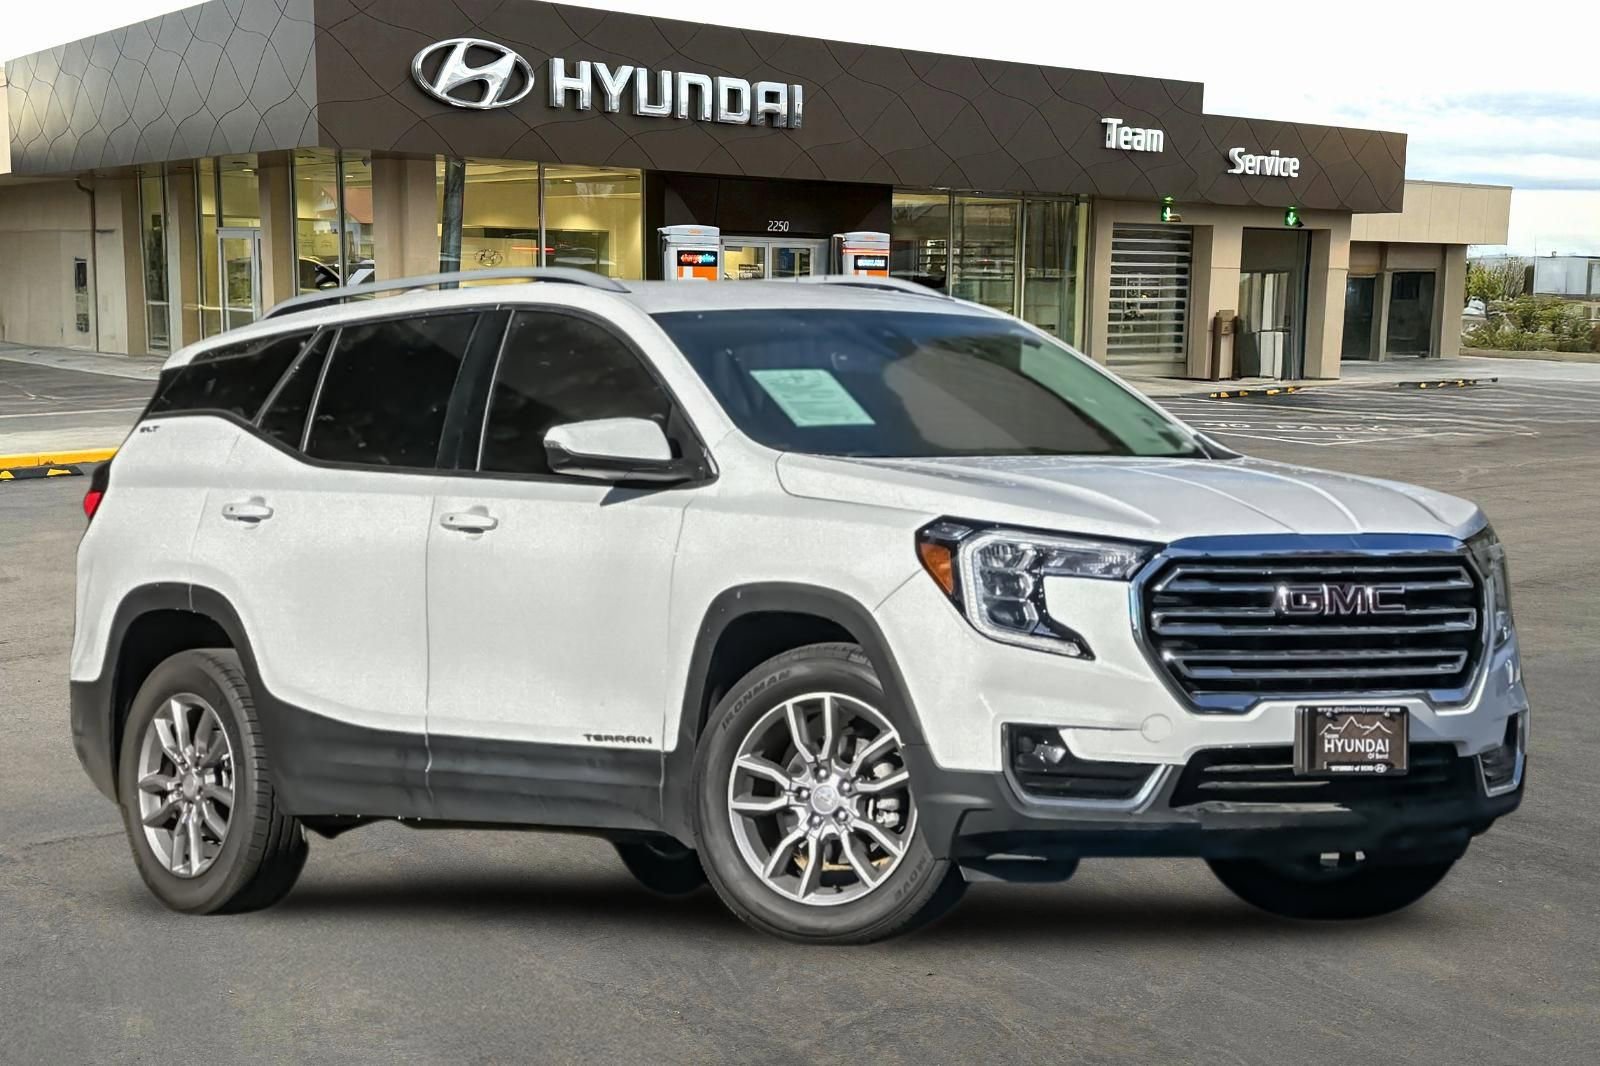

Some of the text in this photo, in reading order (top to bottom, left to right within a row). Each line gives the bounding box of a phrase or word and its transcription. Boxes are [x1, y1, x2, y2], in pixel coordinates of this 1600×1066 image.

[549, 57, 803, 129] HYUNDAI
[1101, 117, 1164, 152] Team
[1227, 147, 1300, 178] Service
[767, 220, 789, 232] 2250
[1277, 584, 1406, 615] GMC
[720, 669, 792, 731] IRONMAN
[583, 733, 652, 744] TERRAIN
[1324, 738, 1389, 753] HYUNDAI
